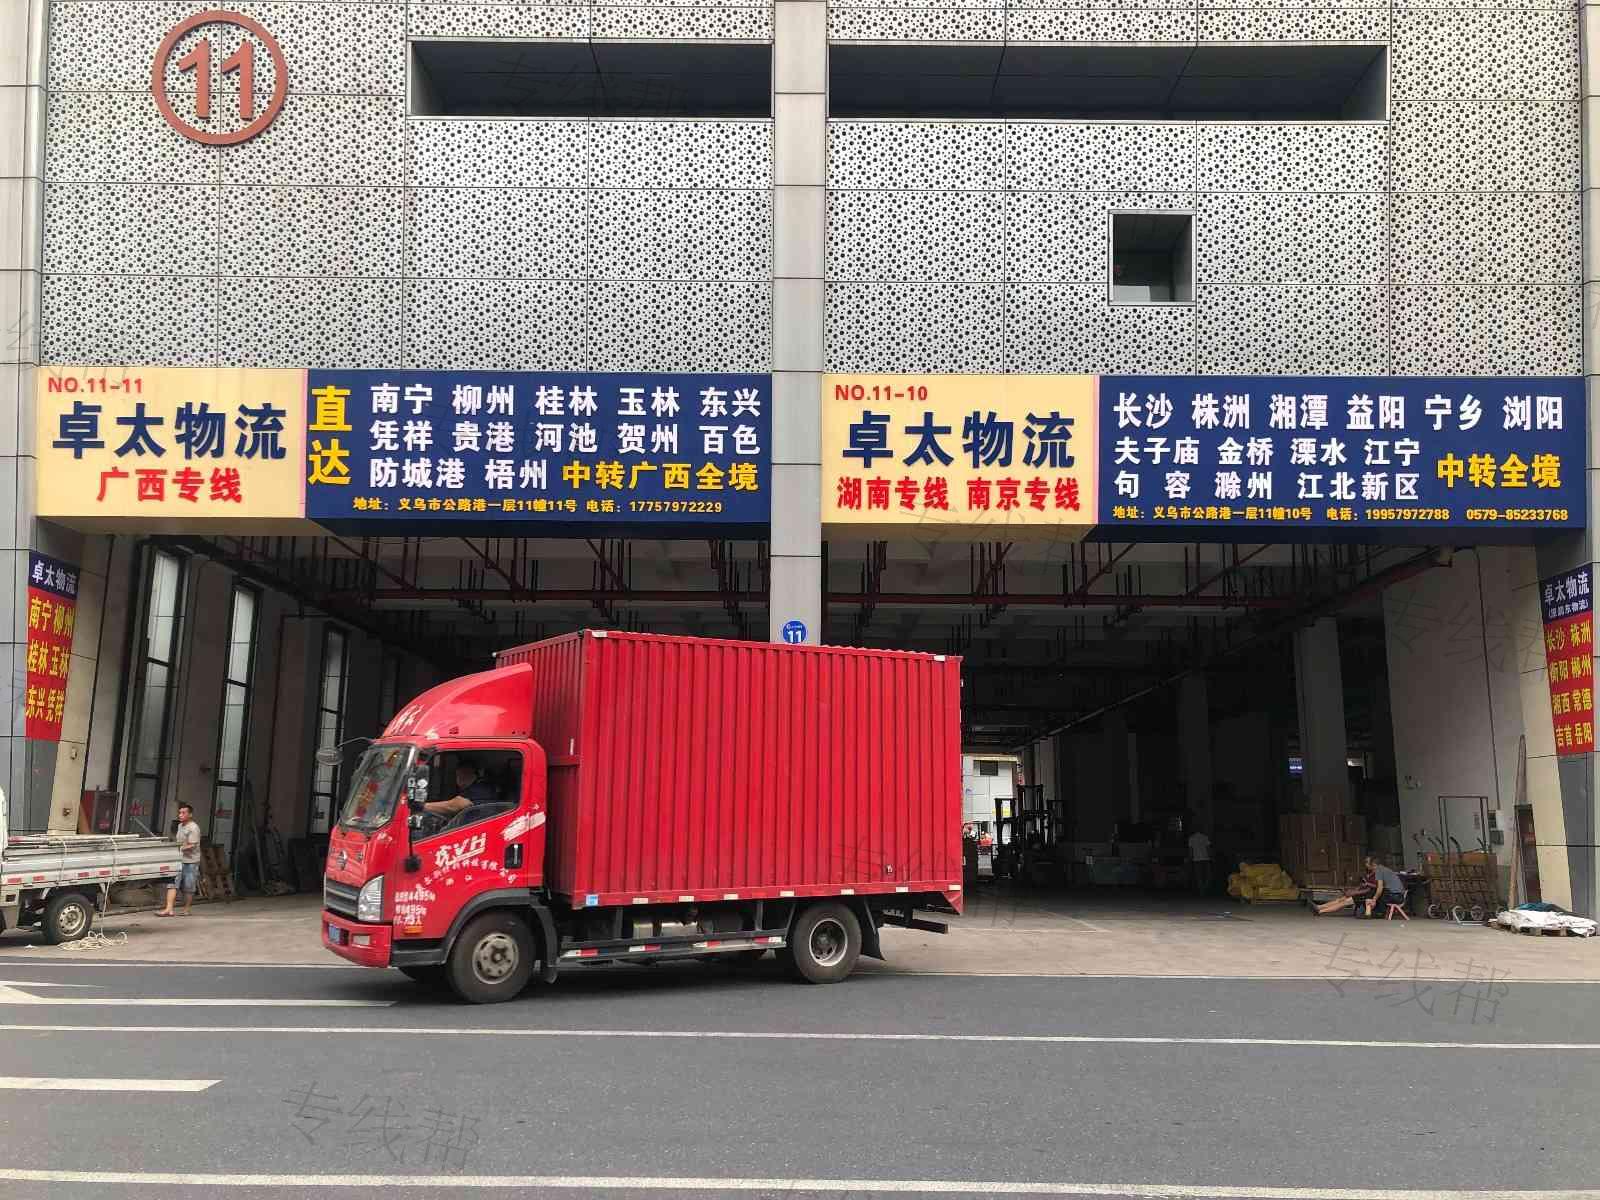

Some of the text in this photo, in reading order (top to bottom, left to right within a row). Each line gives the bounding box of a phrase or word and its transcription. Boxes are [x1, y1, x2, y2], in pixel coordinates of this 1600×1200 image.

[178, 39, 254, 121] 11
[48, 378, 141, 393] NO.11-11
[371, 383, 760, 417] 南宁 柳州 桂林 玉林 东兴
[834, 385, 928, 400] NO.11-10
[1114, 393, 1562, 430] 长沙 株洲 湘潭 益阳 宁乡 浏阳
[53, 401, 286, 459] 卓太物流
[308, 386, 352, 484] 直达
[370, 420, 760, 454] 凭祥 贵港 河池 贺州 百色
[843, 411, 1074, 468] 卓太物流
[1115, 437, 1419, 466] 夫子庙 金桥 溧水 江宁
[96, 466, 242, 504] 广西专线
[370, 457, 758, 490] 防城港 梧州 中转广西全境
[1215, 471, 1272, 499] 滁州
[1298, 472, 1419, 500] 江北新区
[1438, 454, 1560, 488] 中转全境
[837, 476, 1080, 512] 湖南专线 南京专线
[32, 559, 77, 594] 卓太物流
[1544, 571, 1590, 605] 卓太物流
[29, 597, 75, 638] 南宁 柳州
[787, 630, 802, 643] 11
[1546, 620, 1591, 651] 长沙 株洲
[27, 639, 70, 678] 桂林 玉林
[26, 686, 45, 718] 东兴
